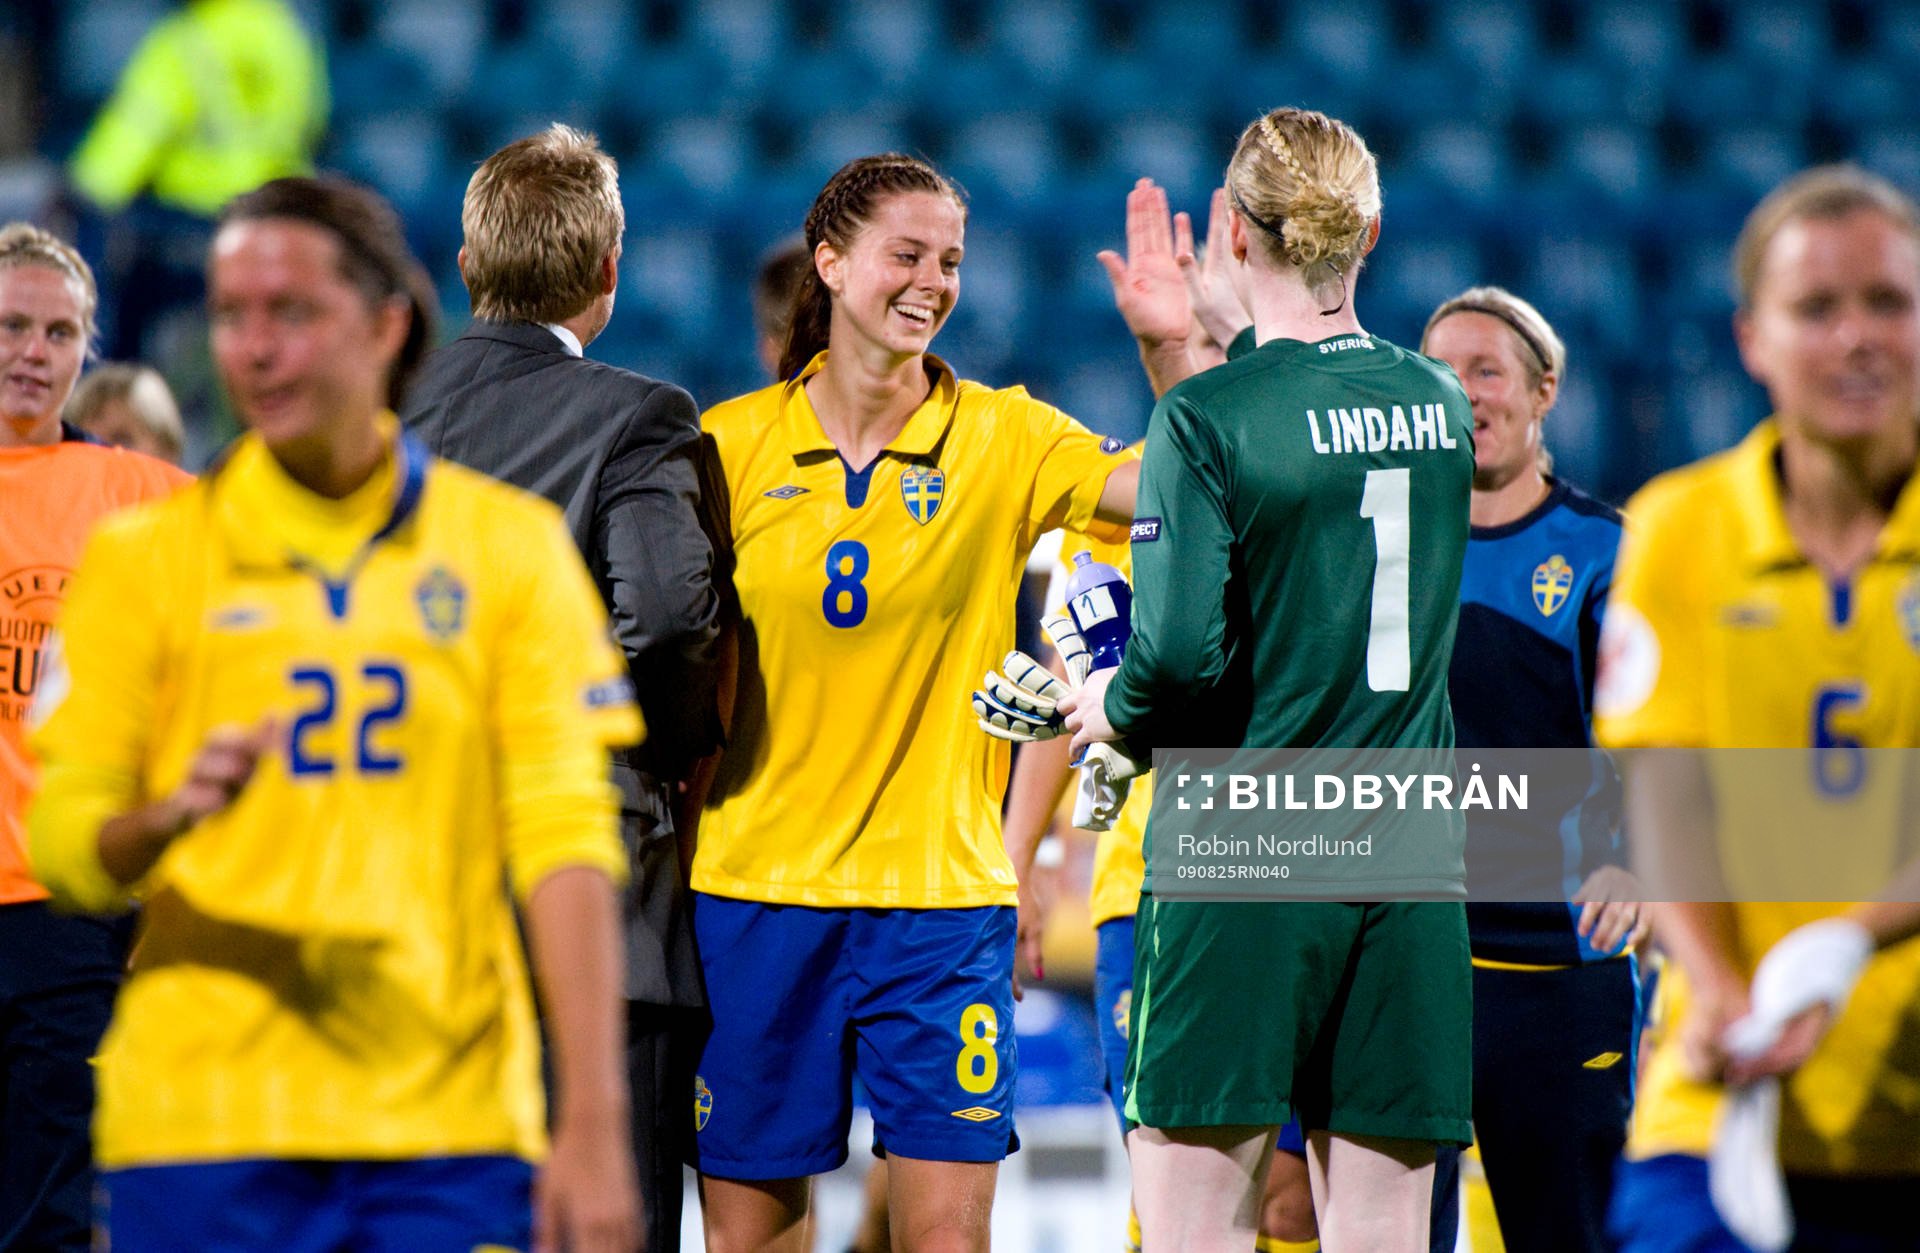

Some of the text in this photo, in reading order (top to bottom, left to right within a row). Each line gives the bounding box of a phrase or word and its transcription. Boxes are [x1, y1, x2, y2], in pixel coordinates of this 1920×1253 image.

[1306, 403, 1457, 454] LINDAHL
[822, 540, 869, 628] 8
[1359, 468, 1411, 692] 1
[288, 663, 407, 777] 22
[1812, 685, 1867, 800] 6
[956, 1003, 998, 1094] 8
